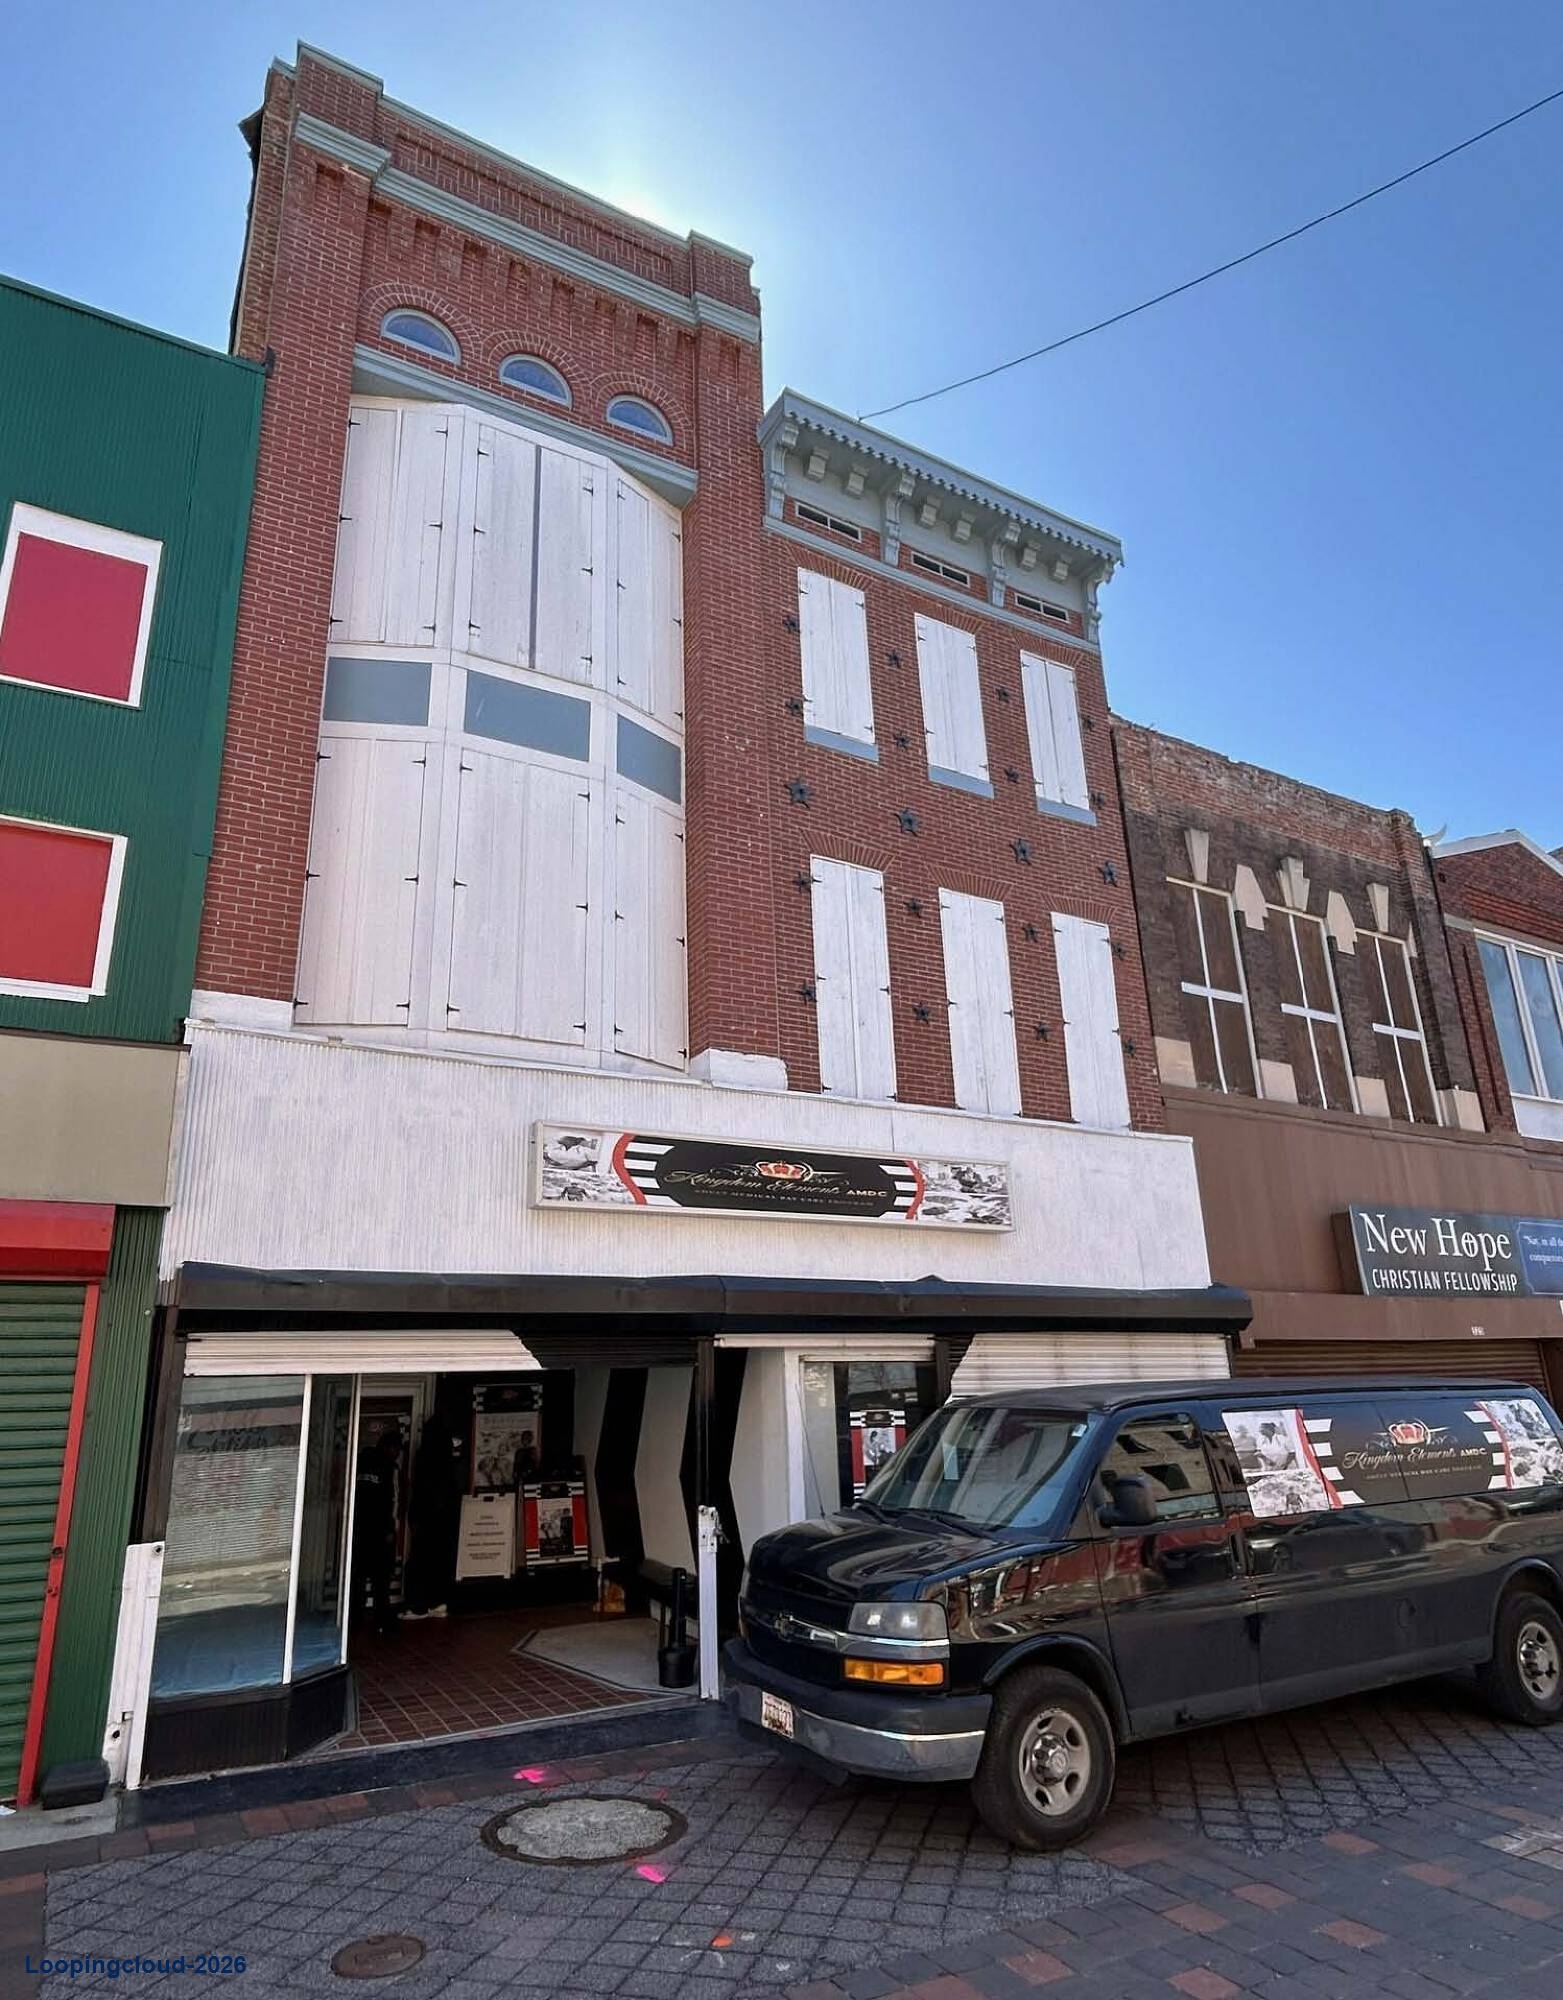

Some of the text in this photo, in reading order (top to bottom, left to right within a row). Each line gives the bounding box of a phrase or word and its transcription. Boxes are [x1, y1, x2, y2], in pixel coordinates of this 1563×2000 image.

[664, 1170, 887, 1197] Kingdom Elements AMDC
[1359, 1213, 1512, 1272] New Hope
[1372, 1268, 1518, 1292] CHRISTIAN FELLOWSHIP
[1342, 1451, 1403, 1470] Kingdom
[1460, 1447, 1488, 1457] AMDC
